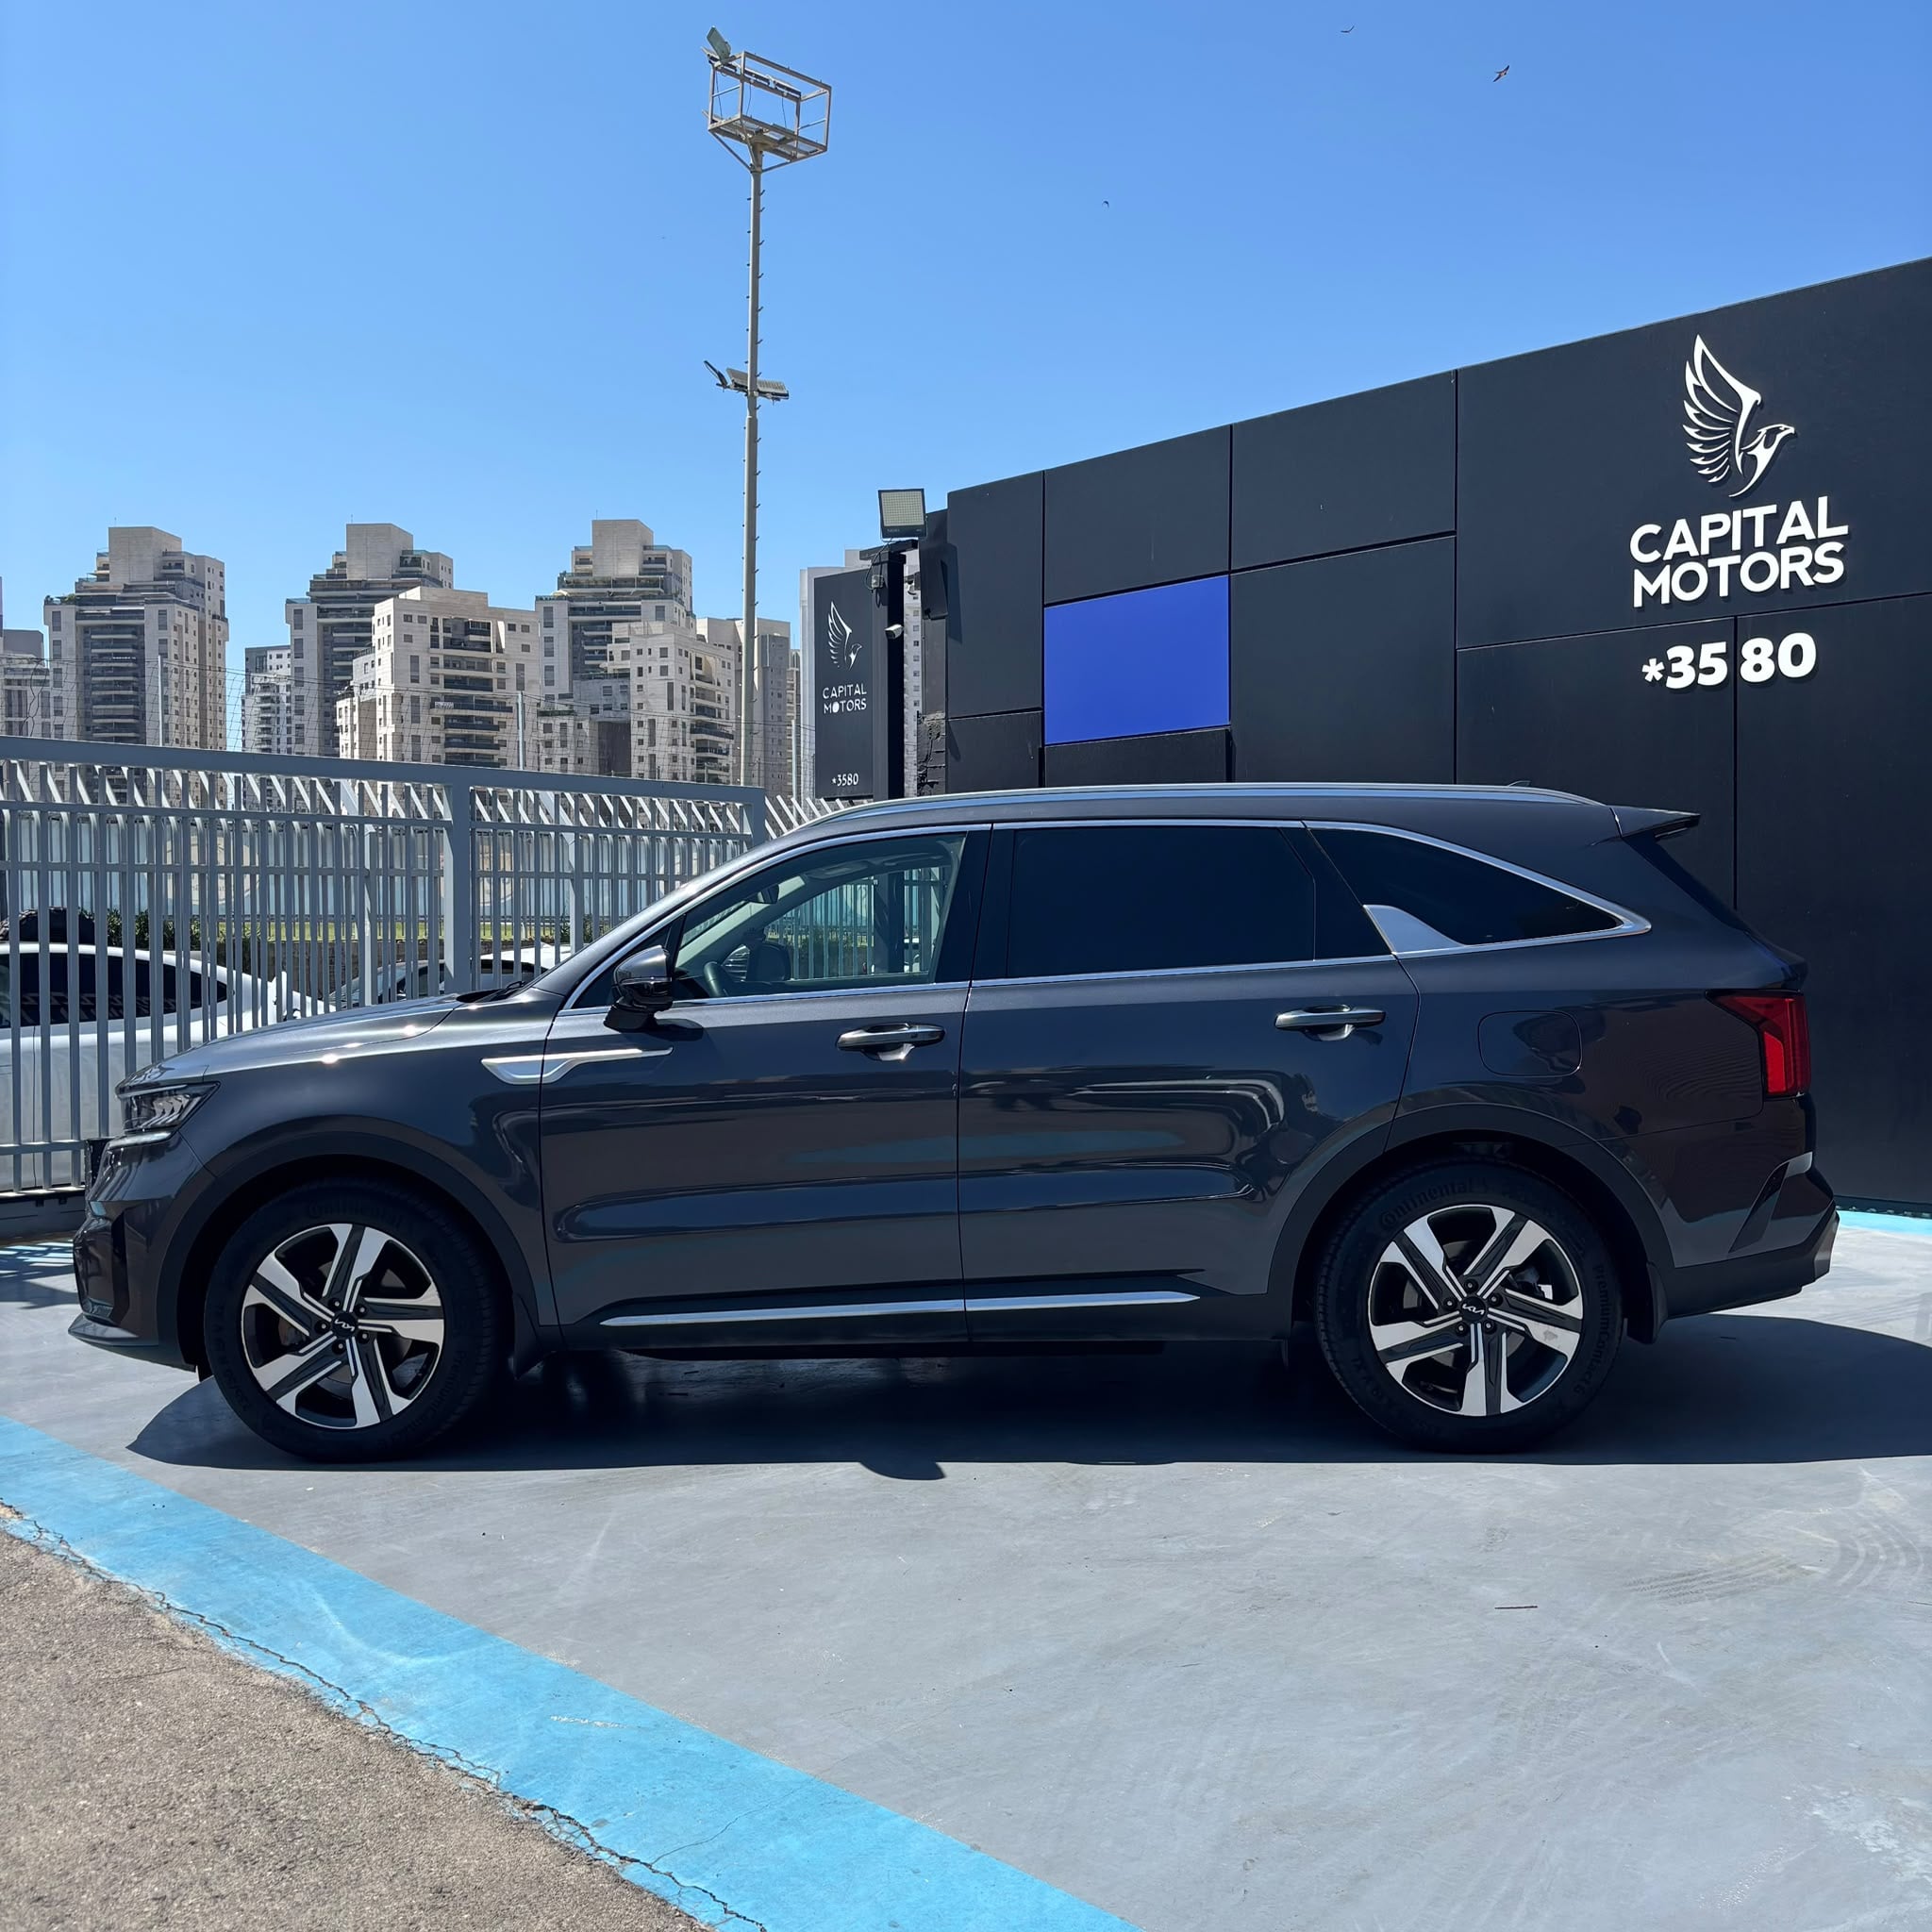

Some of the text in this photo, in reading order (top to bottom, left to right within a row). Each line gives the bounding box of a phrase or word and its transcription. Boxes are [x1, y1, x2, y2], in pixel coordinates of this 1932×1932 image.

[1630, 496, 1849, 563] CAPITAL
[1633, 541, 1844, 608] MOTORS
[823, 683, 867, 699] CAPITAL
[824, 698, 867, 714] MOTORS
[1379, 1176, 1473, 1231] Continental
